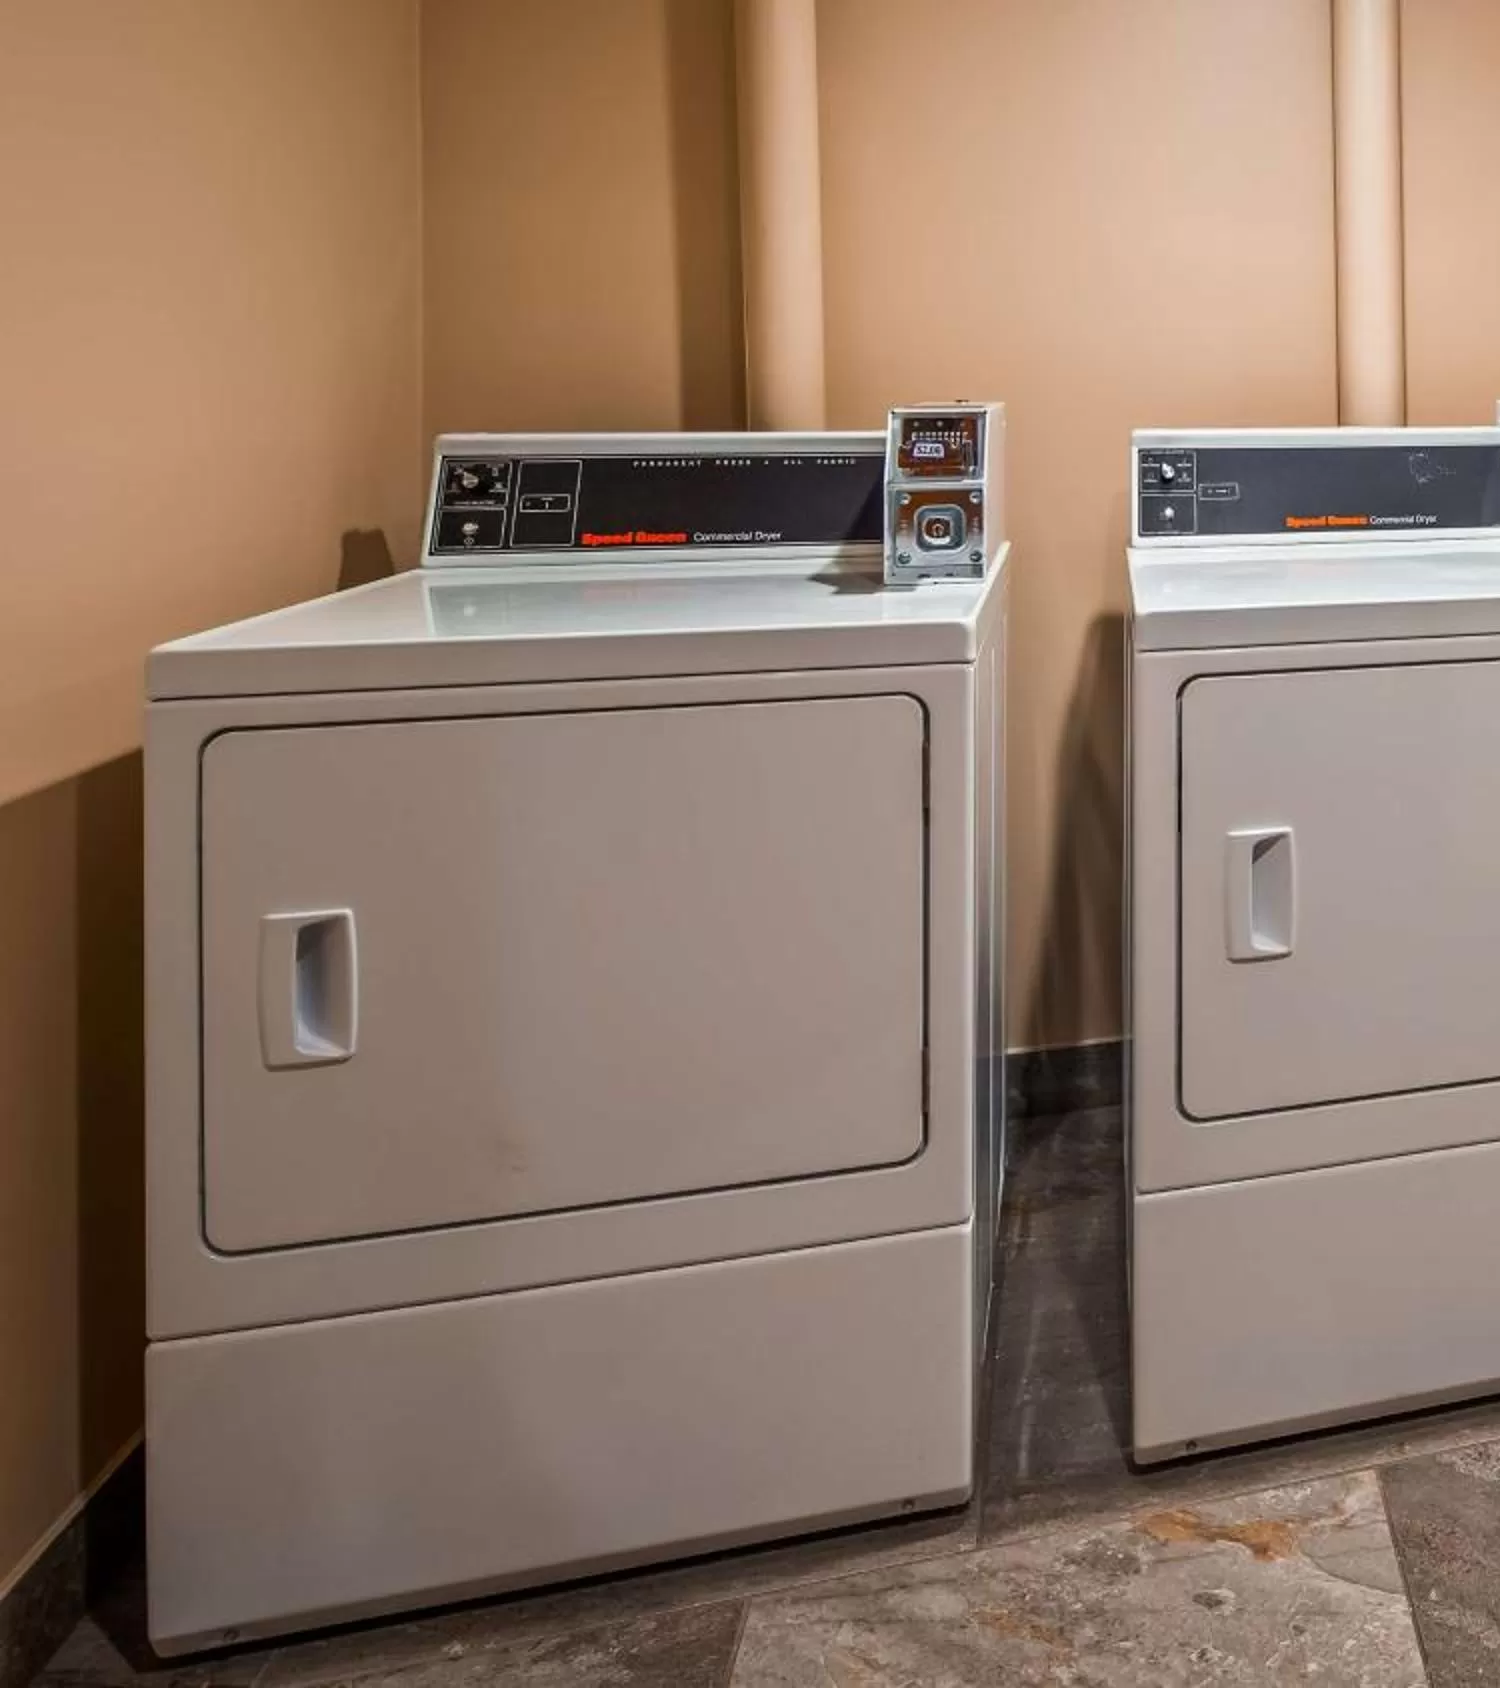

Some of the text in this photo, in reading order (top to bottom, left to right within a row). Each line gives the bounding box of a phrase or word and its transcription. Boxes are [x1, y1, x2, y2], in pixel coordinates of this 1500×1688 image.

[581, 531, 633, 547] Speed
[693, 531, 752, 543] Commercial
[754, 530, 781, 543] Dryer
